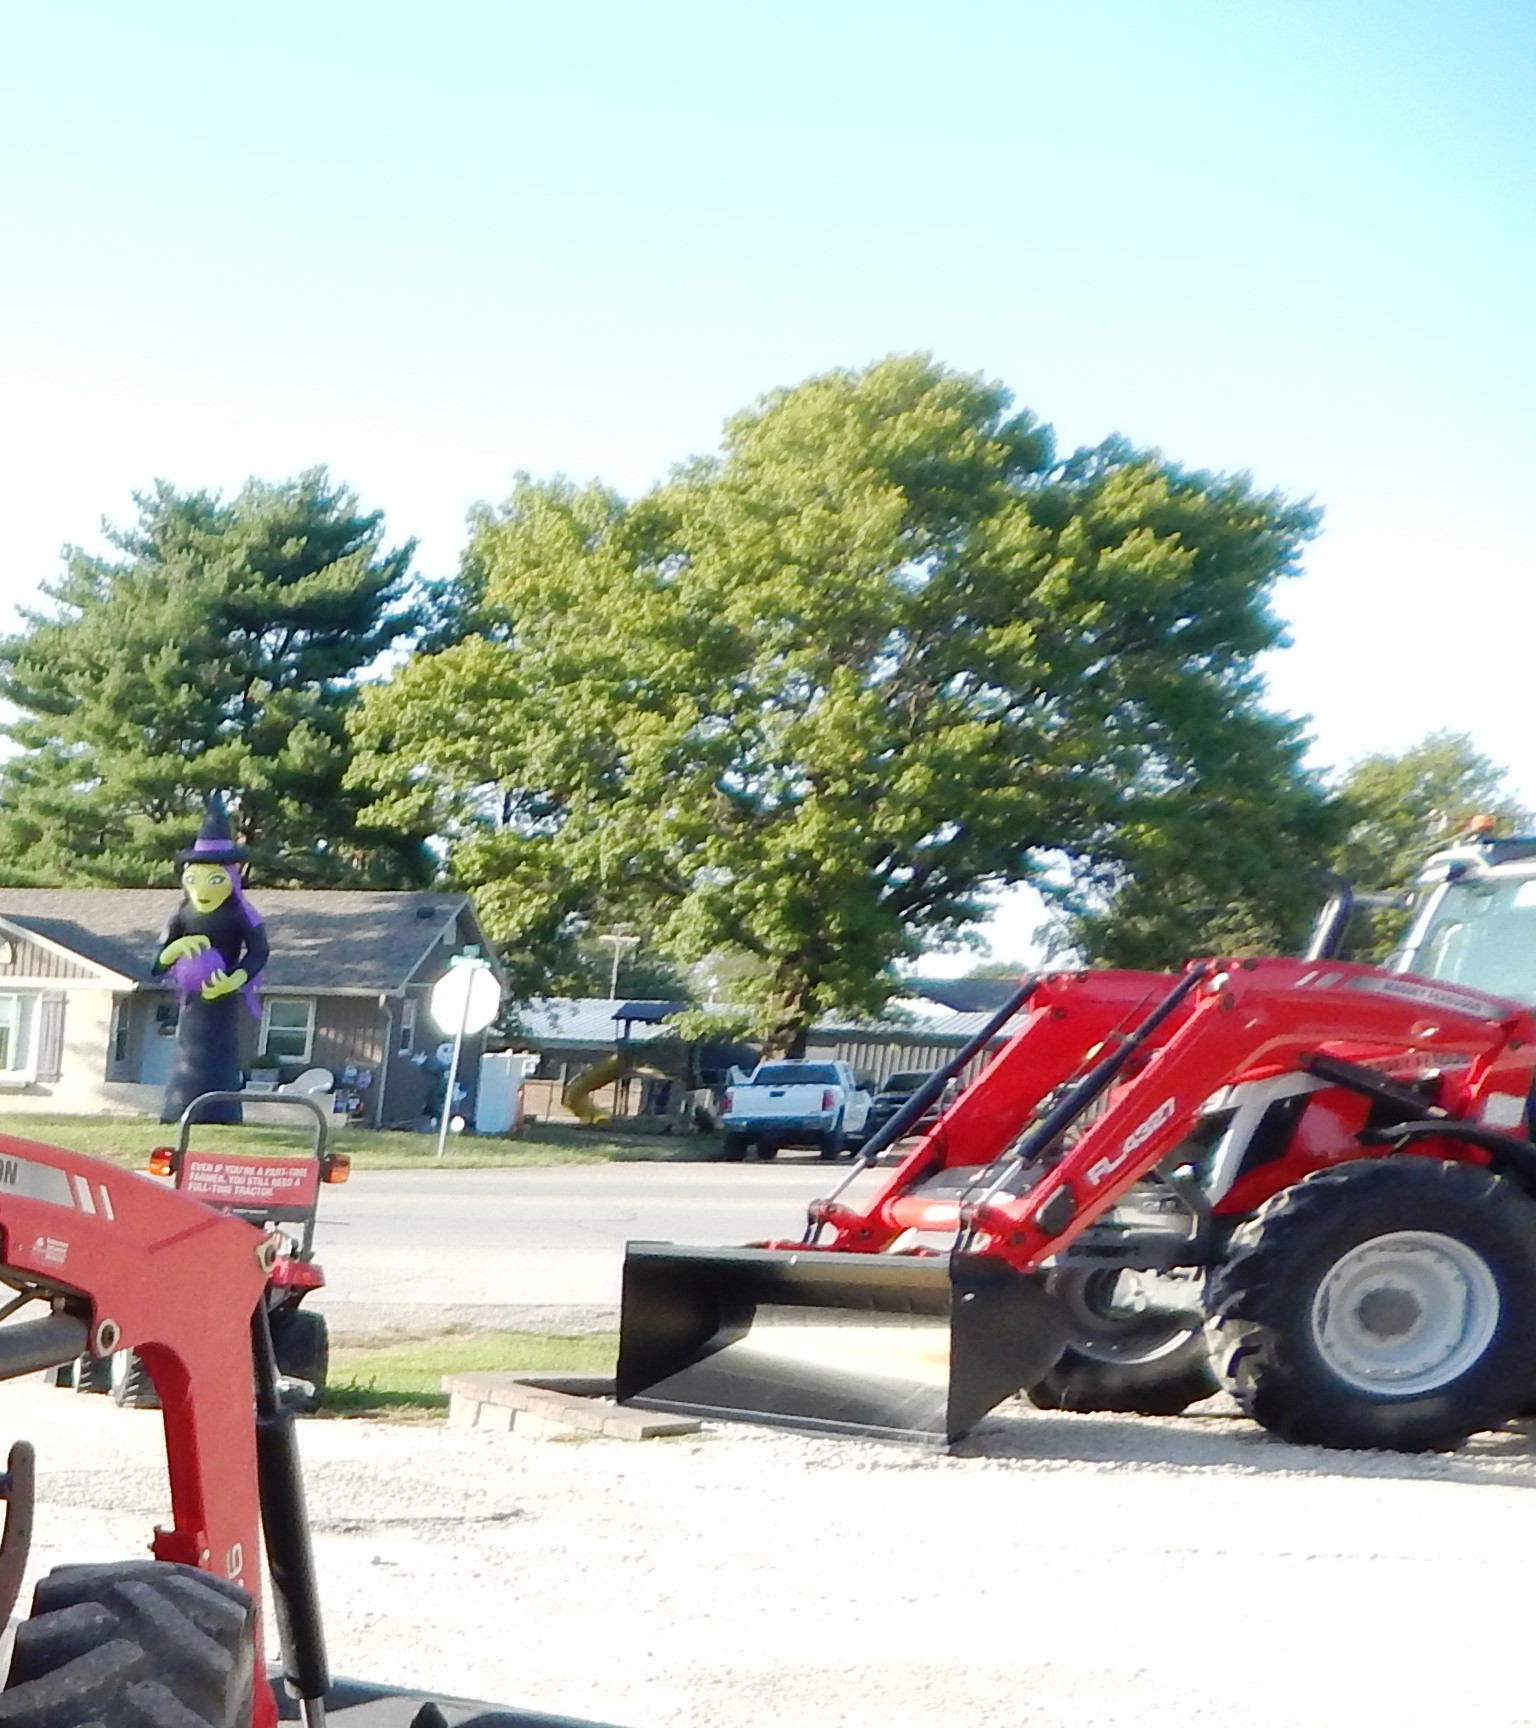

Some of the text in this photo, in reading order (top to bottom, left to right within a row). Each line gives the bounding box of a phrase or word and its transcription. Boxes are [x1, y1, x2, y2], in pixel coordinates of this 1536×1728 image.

[191, 1162, 213, 1173] EVEN
[225, 1164, 255, 1176] YOU'RE
[228, 1175, 246, 1185] YOU
[247, 1176, 269, 1187] STILL
[271, 1178, 293, 1187] NEED
